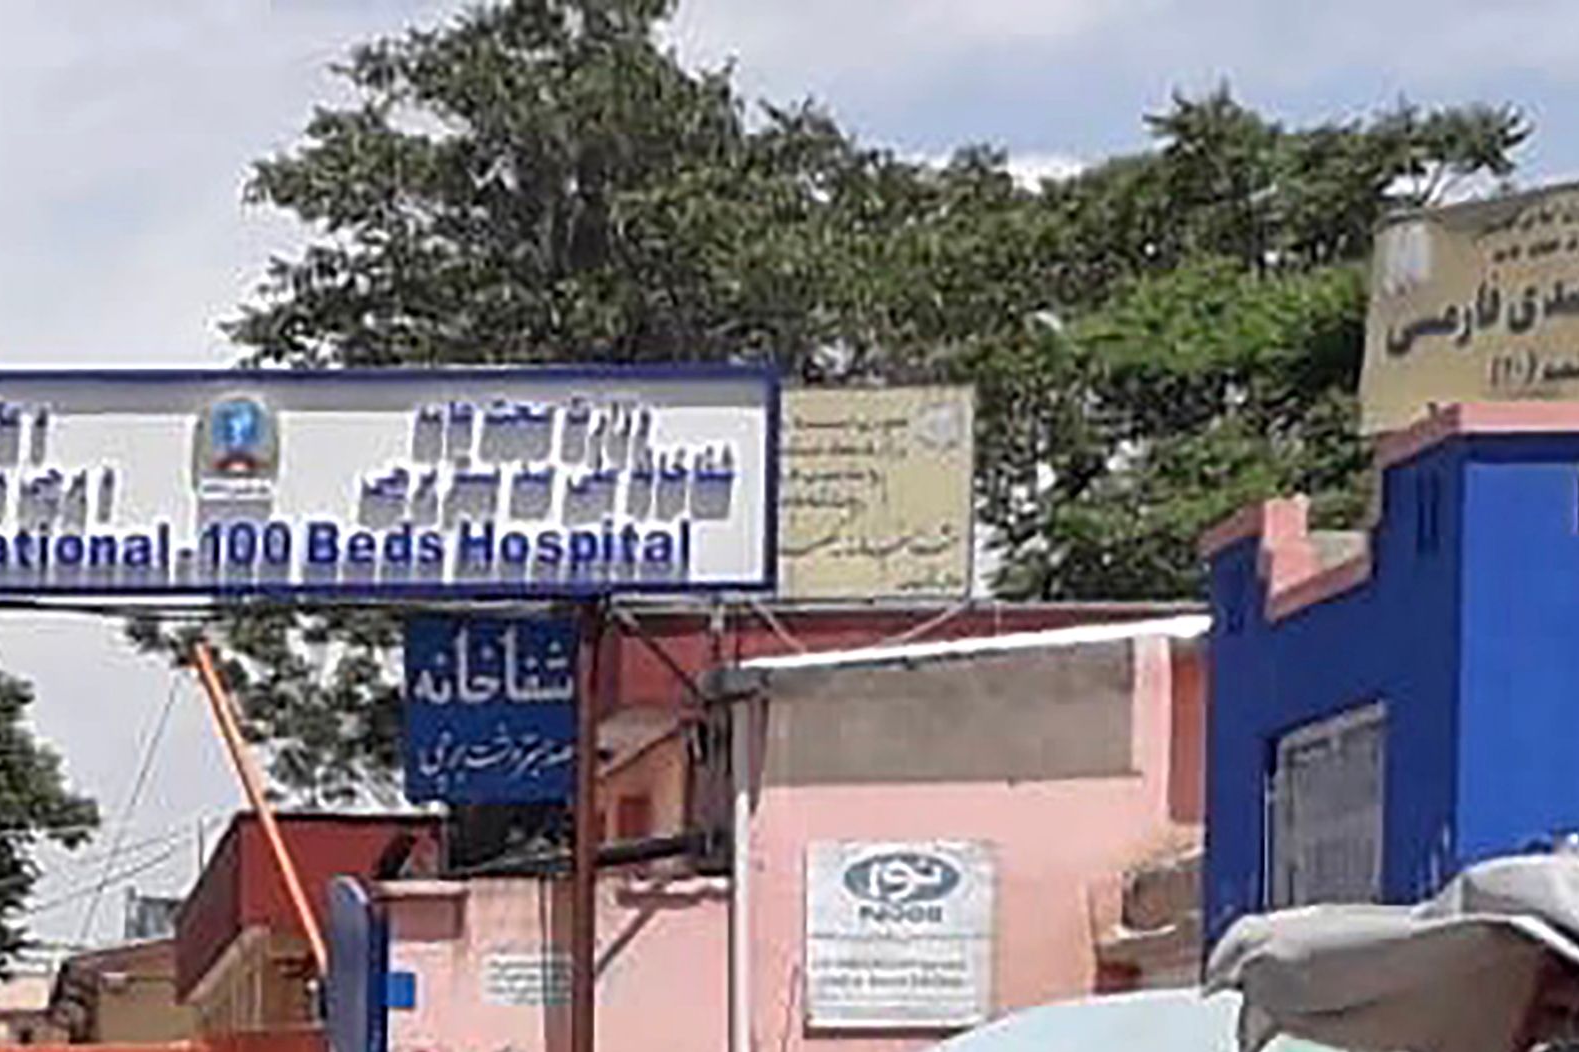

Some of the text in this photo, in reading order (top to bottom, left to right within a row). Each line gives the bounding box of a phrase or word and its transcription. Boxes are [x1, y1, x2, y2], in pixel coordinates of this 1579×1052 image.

[307, 520, 445, 566] Beds
[459, 518, 691, 575] Hospital
[414, 624, 574, 704] شفاخانه
